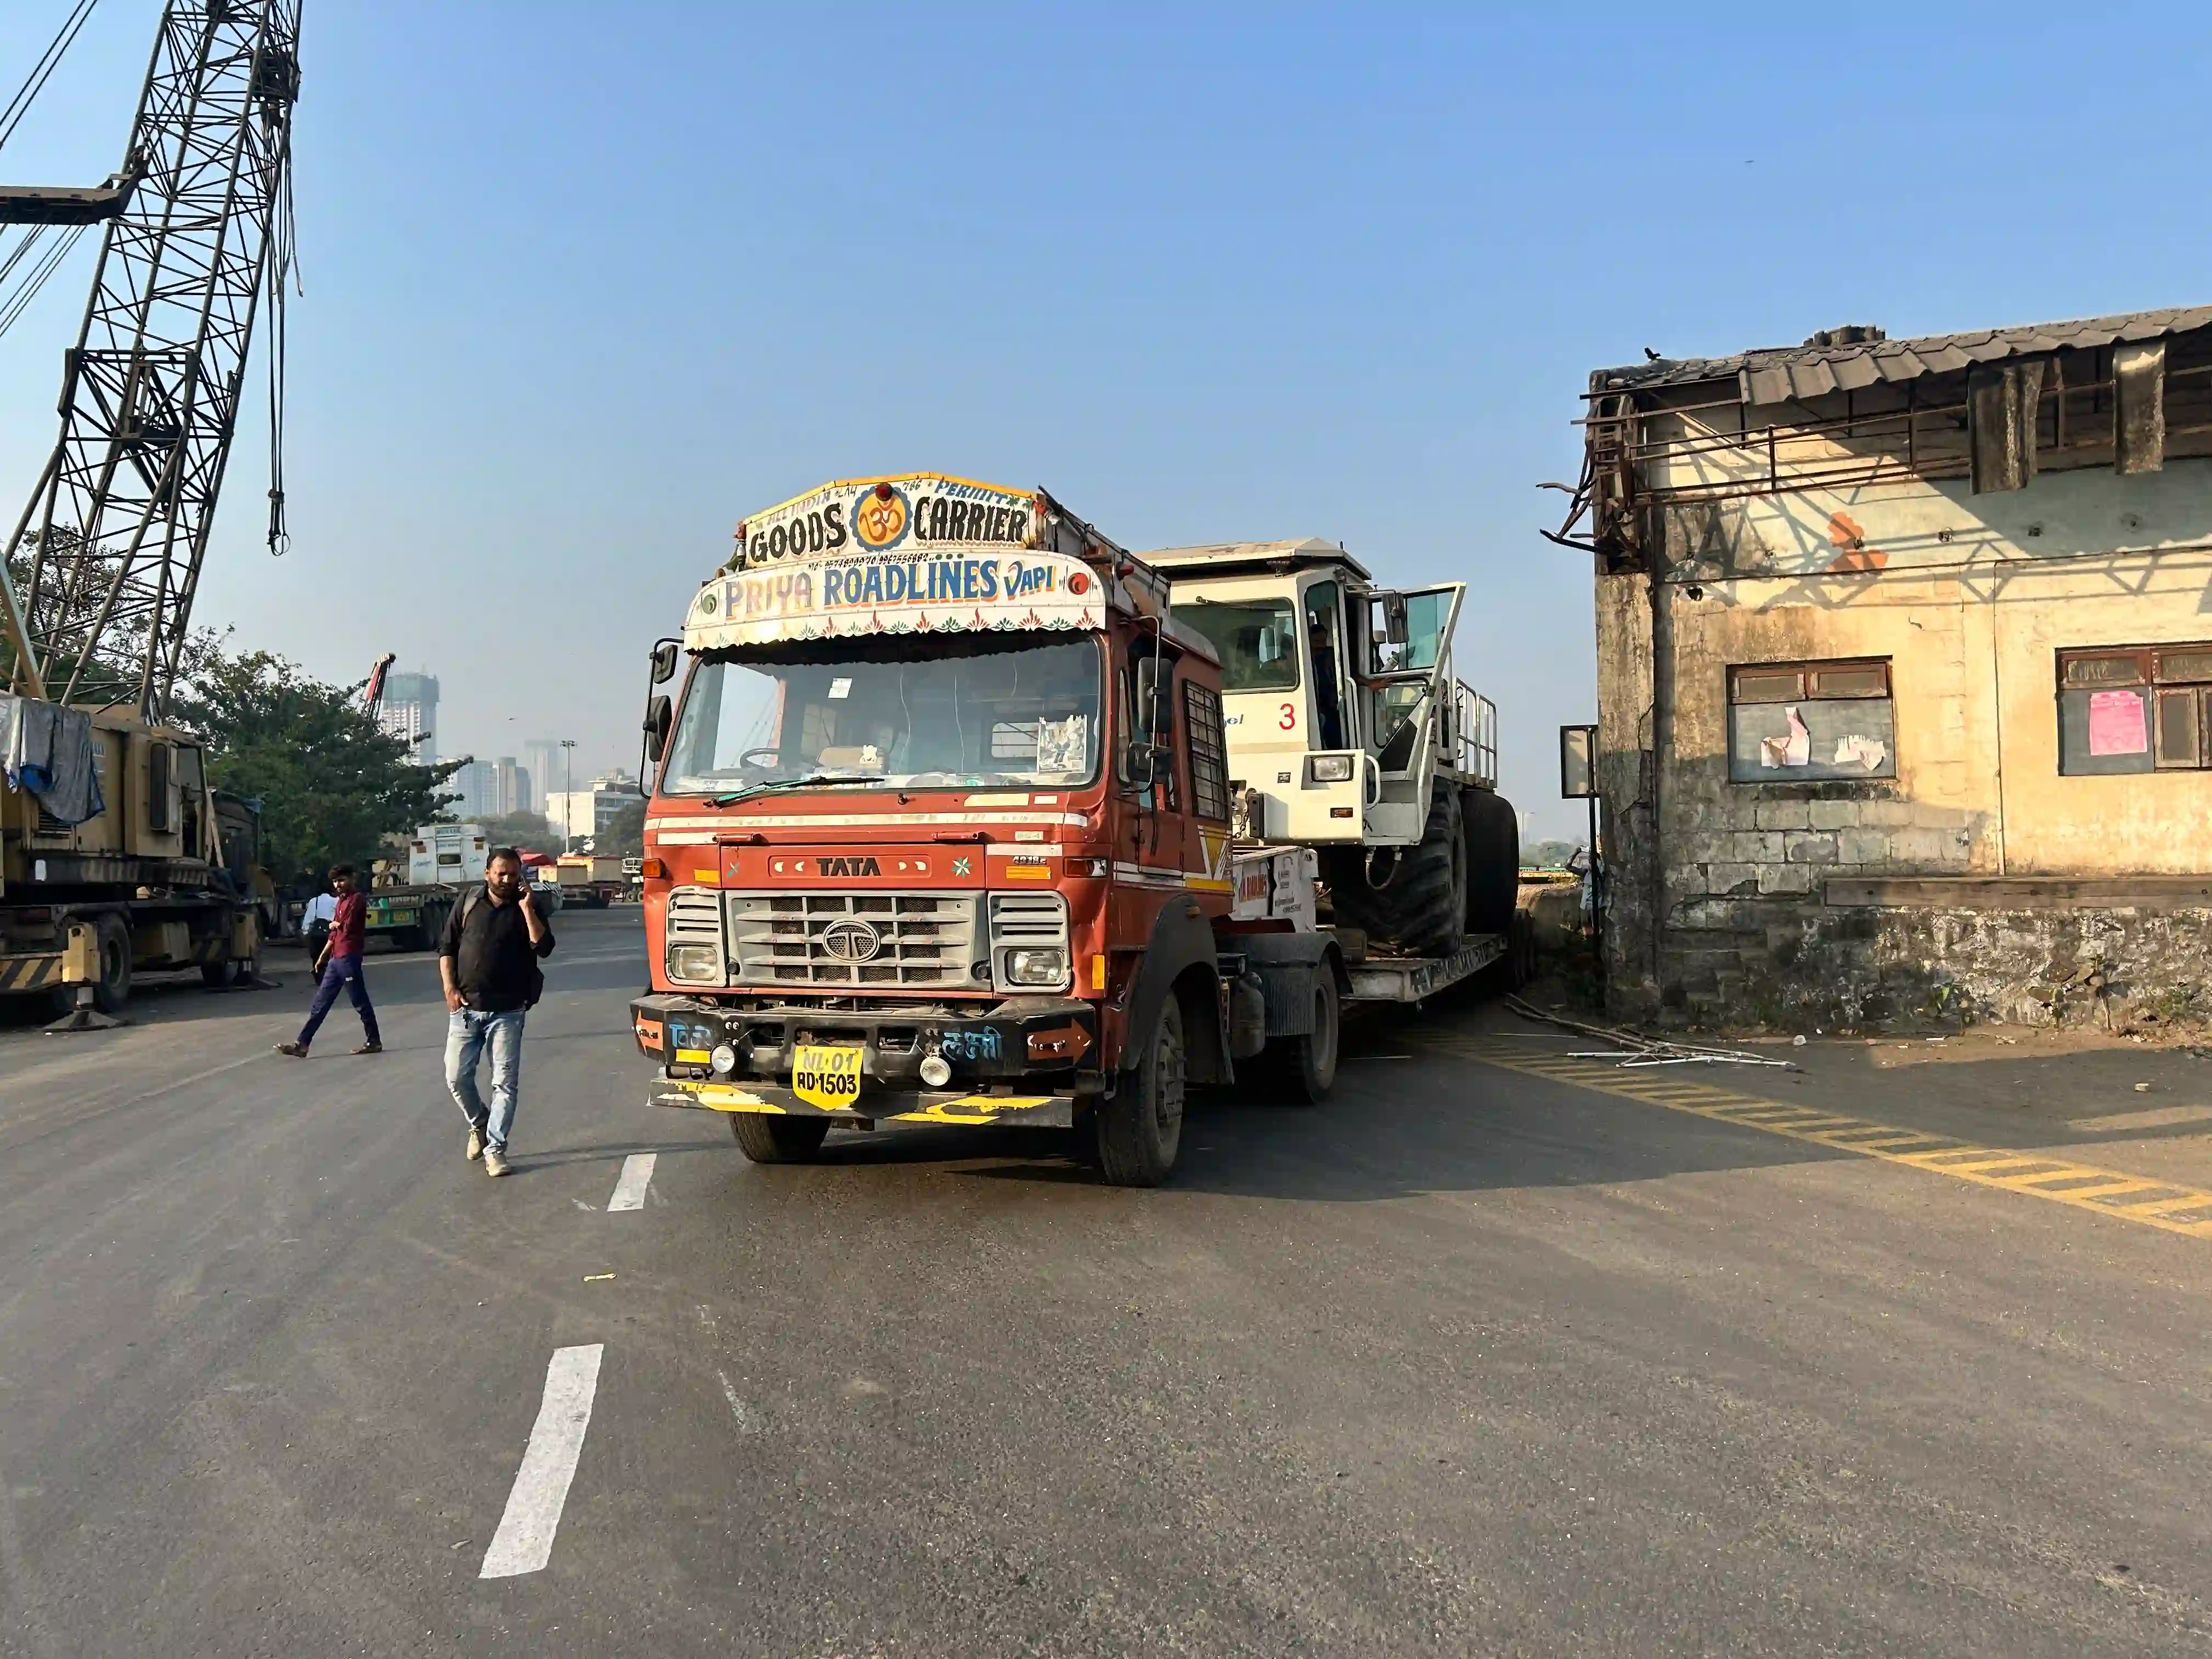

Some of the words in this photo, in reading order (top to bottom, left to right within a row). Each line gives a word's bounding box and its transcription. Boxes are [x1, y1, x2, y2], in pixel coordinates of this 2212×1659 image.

[902, 479, 922, 491] 786
[934, 479, 1009, 504] PERMIT
[791, 490, 831, 516] INDIA
[750, 502, 847, 562] GOODS
[913, 496, 1027, 542] CARRIER
[725, 572, 814, 617] PRIYA
[823, 560, 999, 606] ROADLINES
[1004, 560, 1054, 597] VAPI
[1279, 703, 1295, 730] 3
[816, 857, 882, 877] TATA
